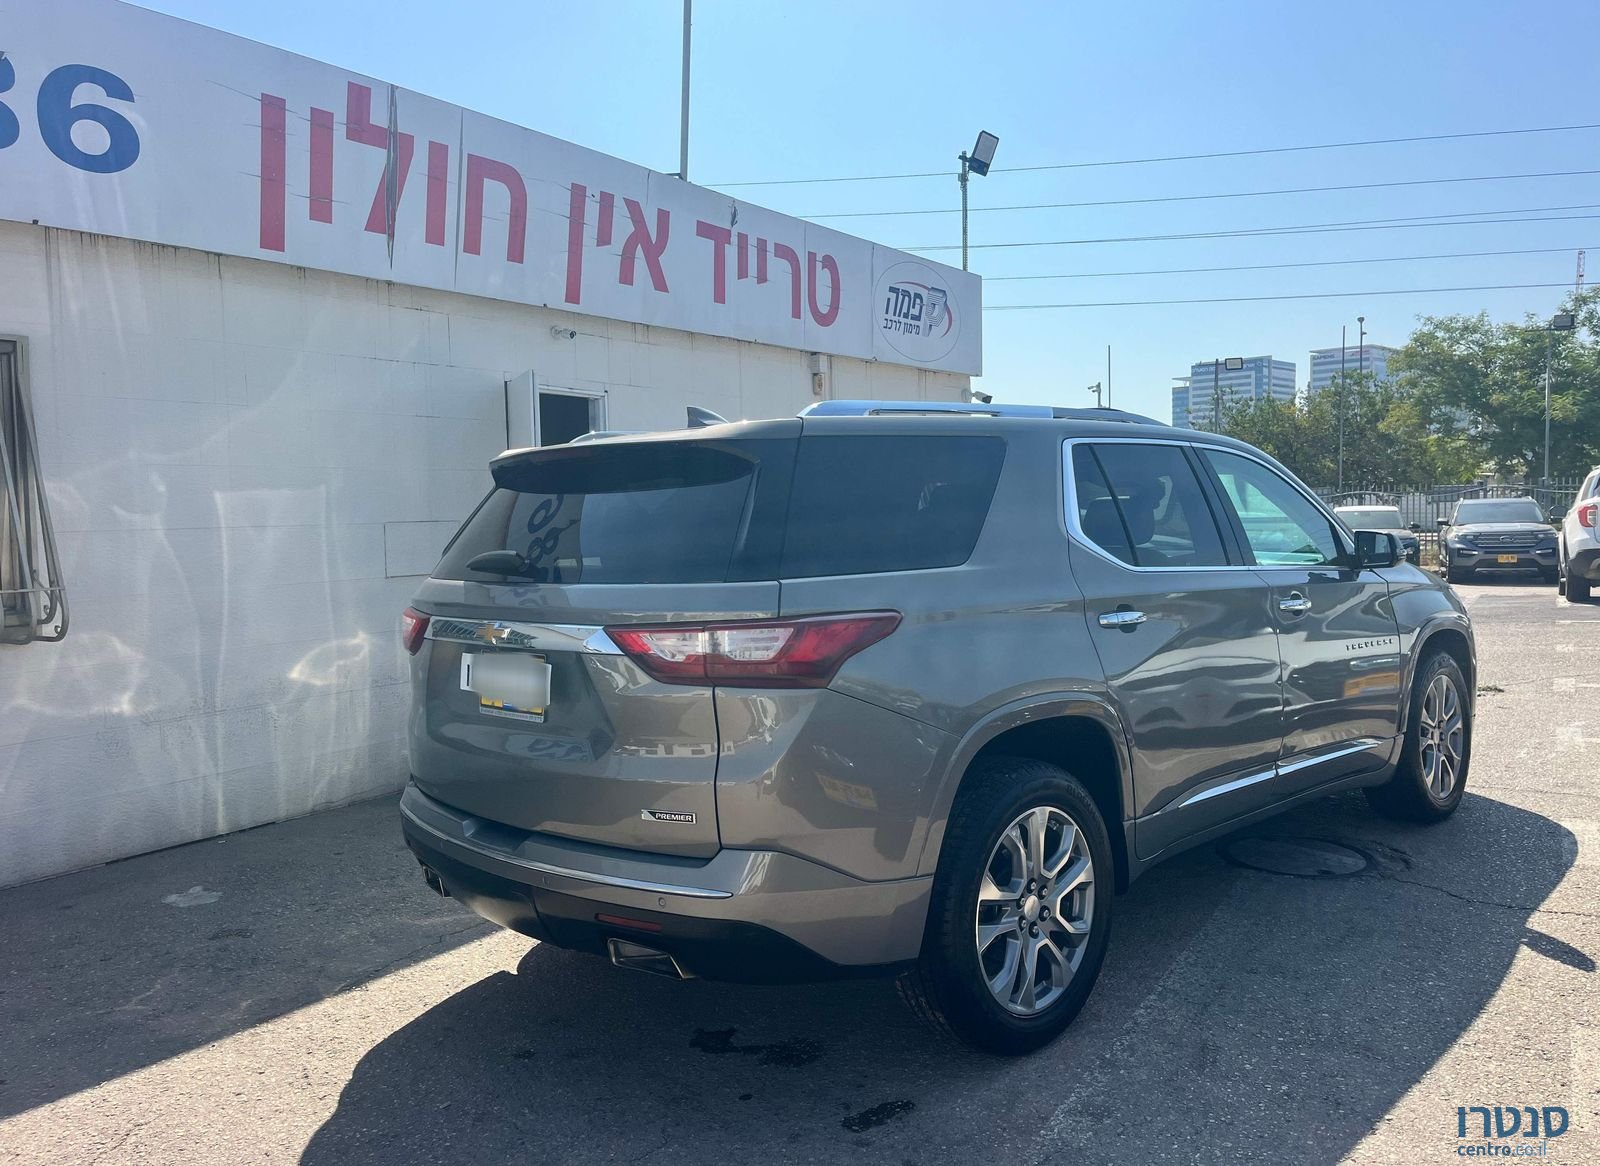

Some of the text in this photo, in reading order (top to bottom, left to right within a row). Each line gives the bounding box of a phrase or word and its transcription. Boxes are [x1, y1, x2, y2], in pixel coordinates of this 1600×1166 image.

[0, 51, 141, 174] 6
[259, 81, 841, 328] טרייד אין חולון
[885, 286, 923, 321] פמה
[883, 318, 920, 335] מימון לרכב
[655, 812, 693, 822] PREMIER
